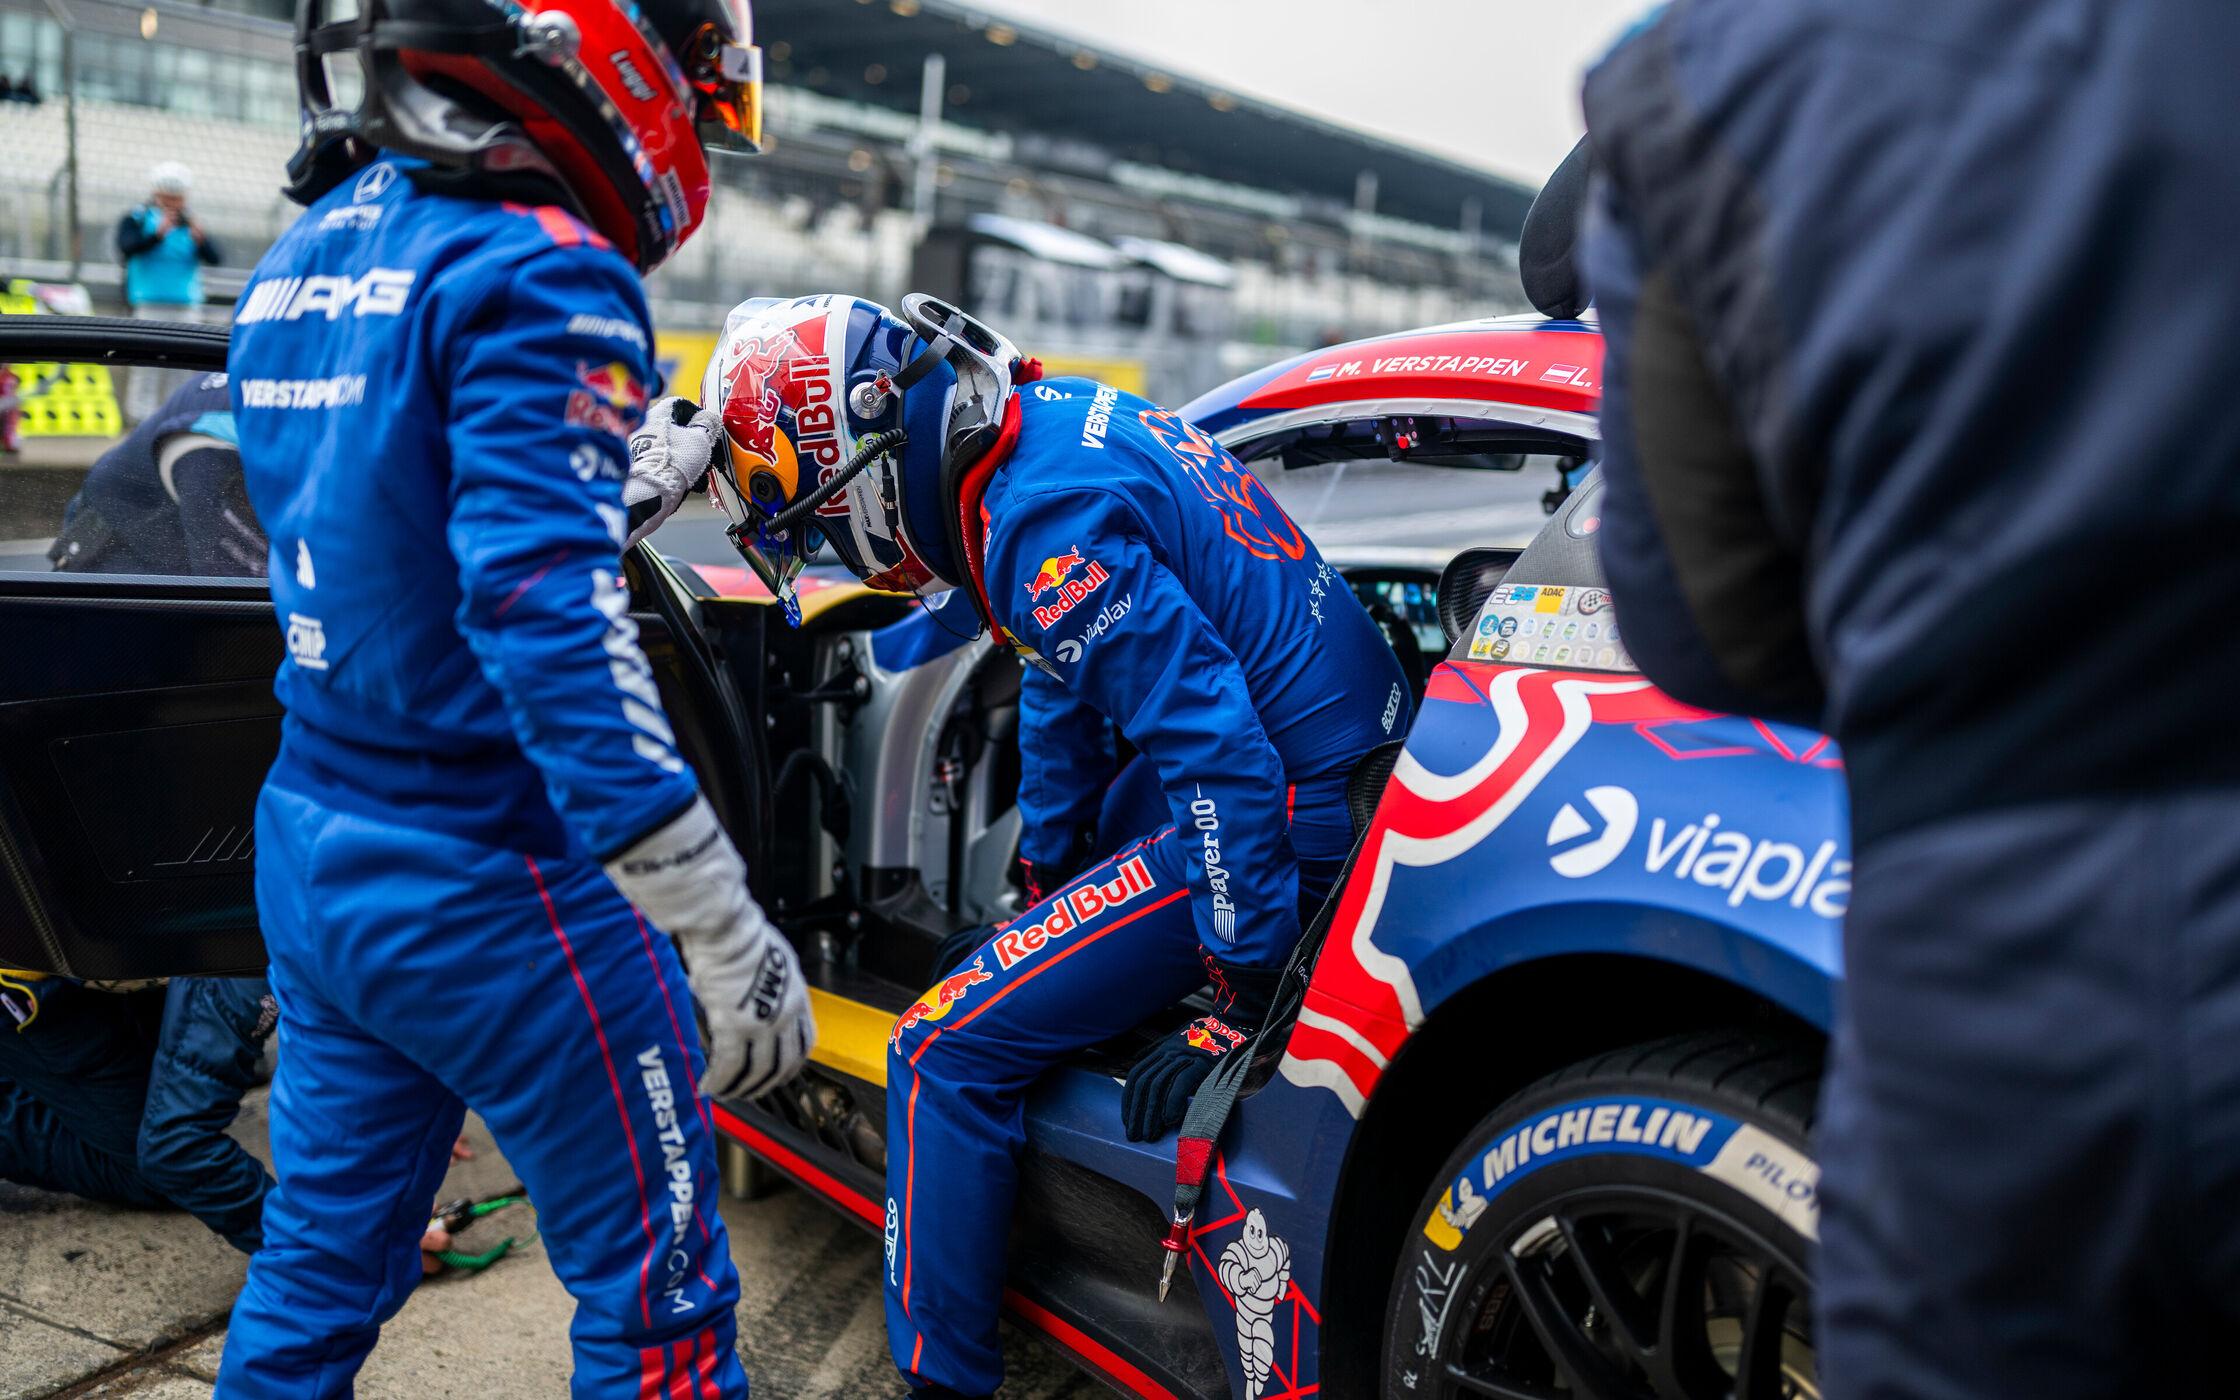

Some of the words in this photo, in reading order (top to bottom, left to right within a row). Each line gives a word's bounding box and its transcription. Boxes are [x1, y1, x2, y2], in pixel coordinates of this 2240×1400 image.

[1337, 361, 1361, 377] M.
[1371, 355, 1529, 377] VERSTAPPEN
[1574, 367, 1593, 387] L.
[1032, 586, 1076, 631] Red
[1063, 559, 1110, 605] Bull
[1540, 587, 1565, 598] ADAC
[992, 896, 1078, 971] Red
[1067, 854, 1157, 925] Bull
[751, 948, 786, 1021] OMP
[1483, 1104, 1711, 1190] MICHELIN
